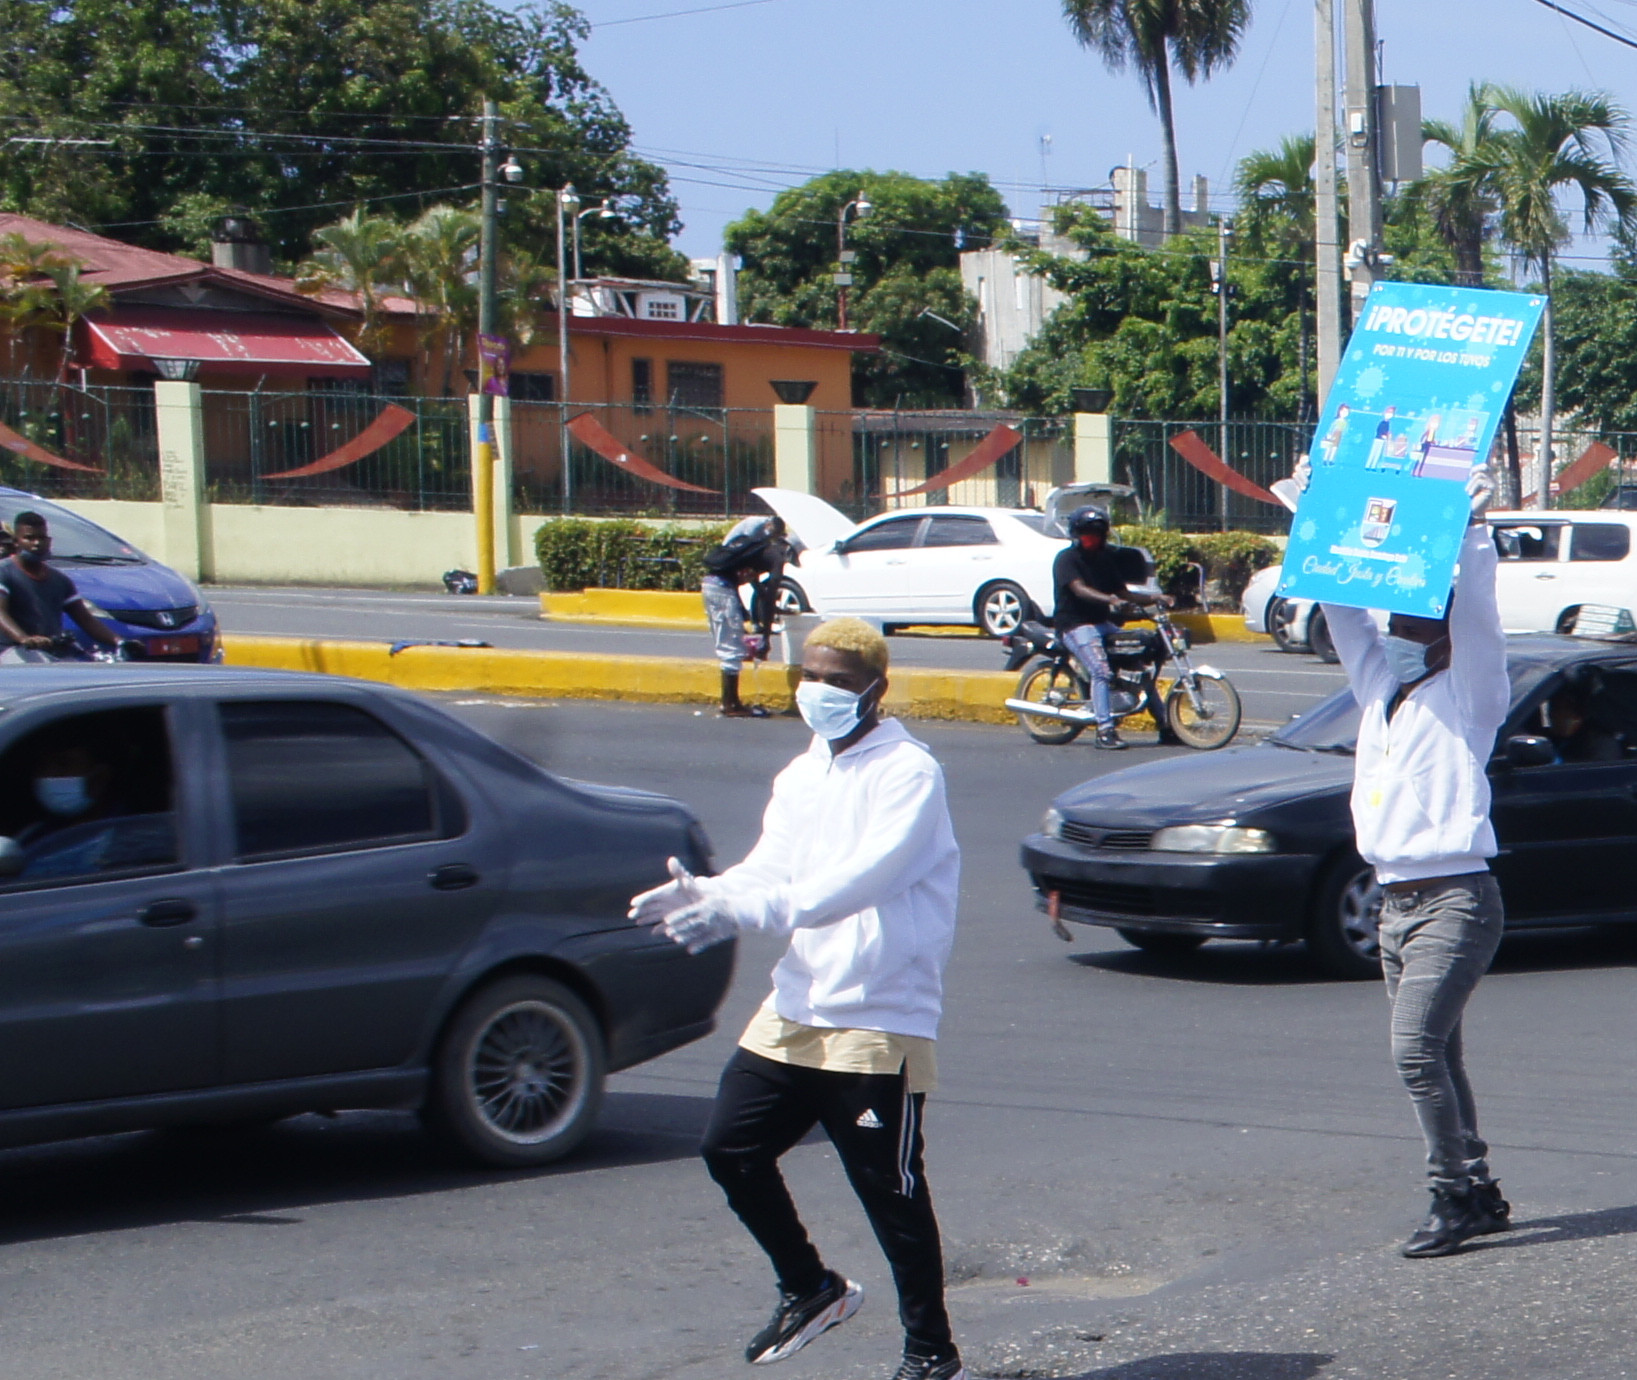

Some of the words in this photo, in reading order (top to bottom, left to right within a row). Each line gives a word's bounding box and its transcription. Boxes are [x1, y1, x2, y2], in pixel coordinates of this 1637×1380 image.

[1365, 305, 1524, 347] ¡PROTÉGETE!
[1373, 343, 1396, 357] POR
[1396, 345, 1406, 357] TI
[1405, 347, 1415, 358] Y
[1414, 348, 1437, 362] POR
[1437, 350, 1458, 365] LOS
[1458, 353, 1492, 368] TUYOS
